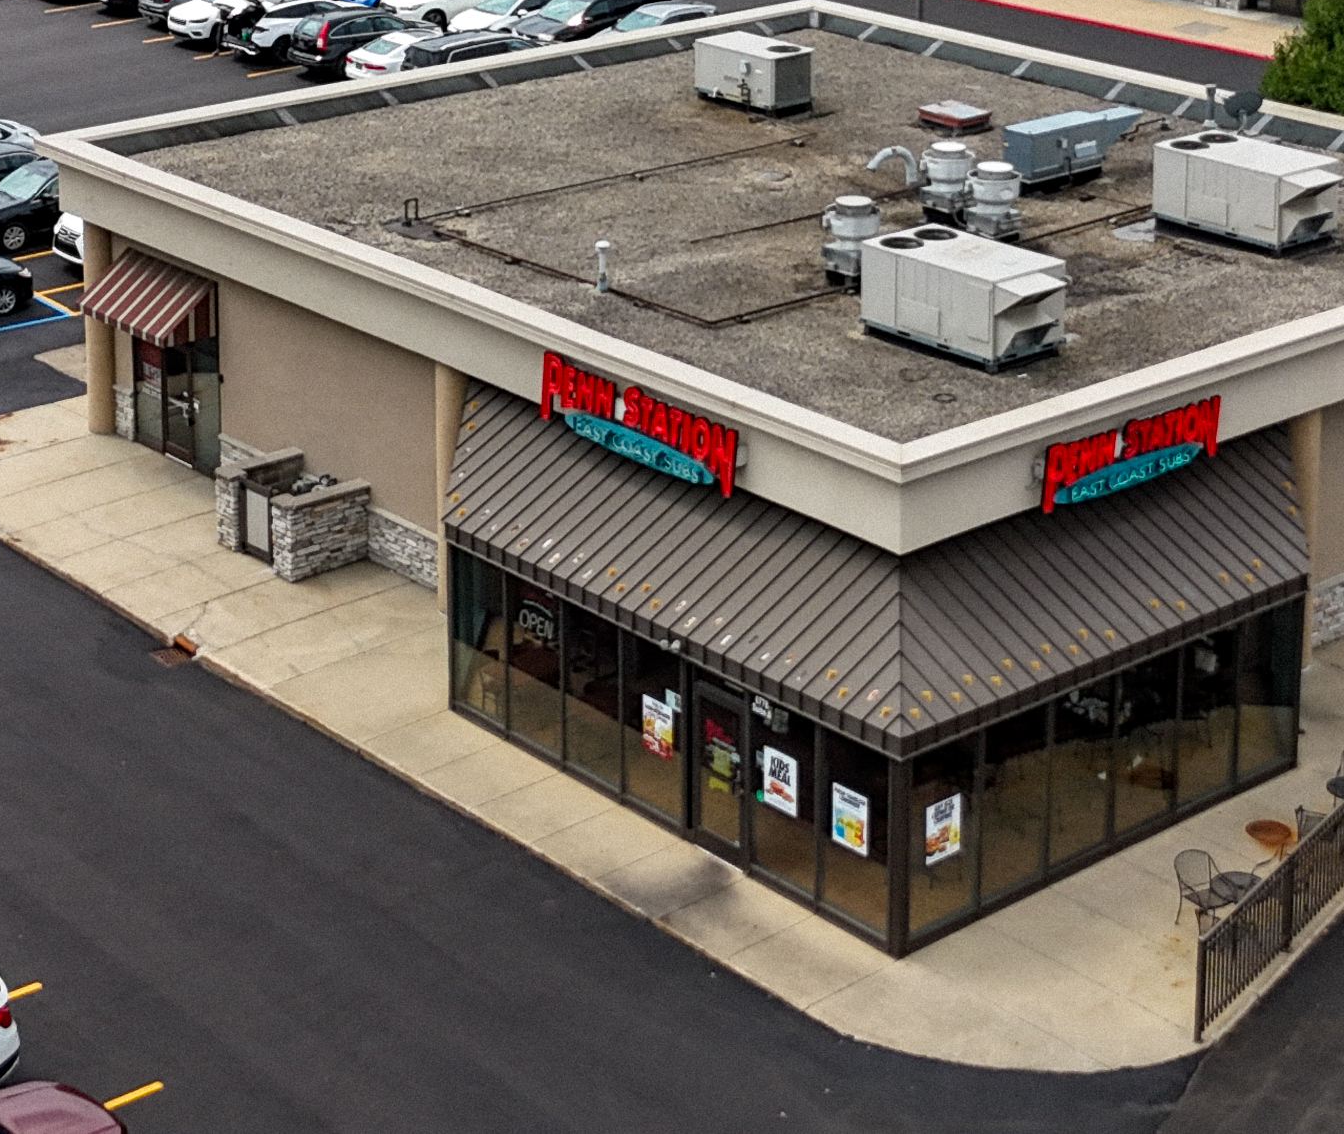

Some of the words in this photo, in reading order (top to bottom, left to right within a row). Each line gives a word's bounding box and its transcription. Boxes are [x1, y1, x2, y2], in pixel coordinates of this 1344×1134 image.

[540, 351, 616, 420] PENN
[623, 386, 739, 498] STATION
[575, 422, 606, 443] EAST
[612, 432, 656, 462] COAST
[663, 455, 699, 484] SUBS
[1041, 429, 1119, 514] PENN
[1122, 395, 1221, 458] STATION
[1071, 479, 1105, 502] EAST
[1109, 463, 1154, 490] COAST
[1158, 452, 1191, 473] SUBS
[519, 608, 554, 640] OPEN
[768, 766, 791, 787] MEAL
[770, 756, 790, 773] KIDS
